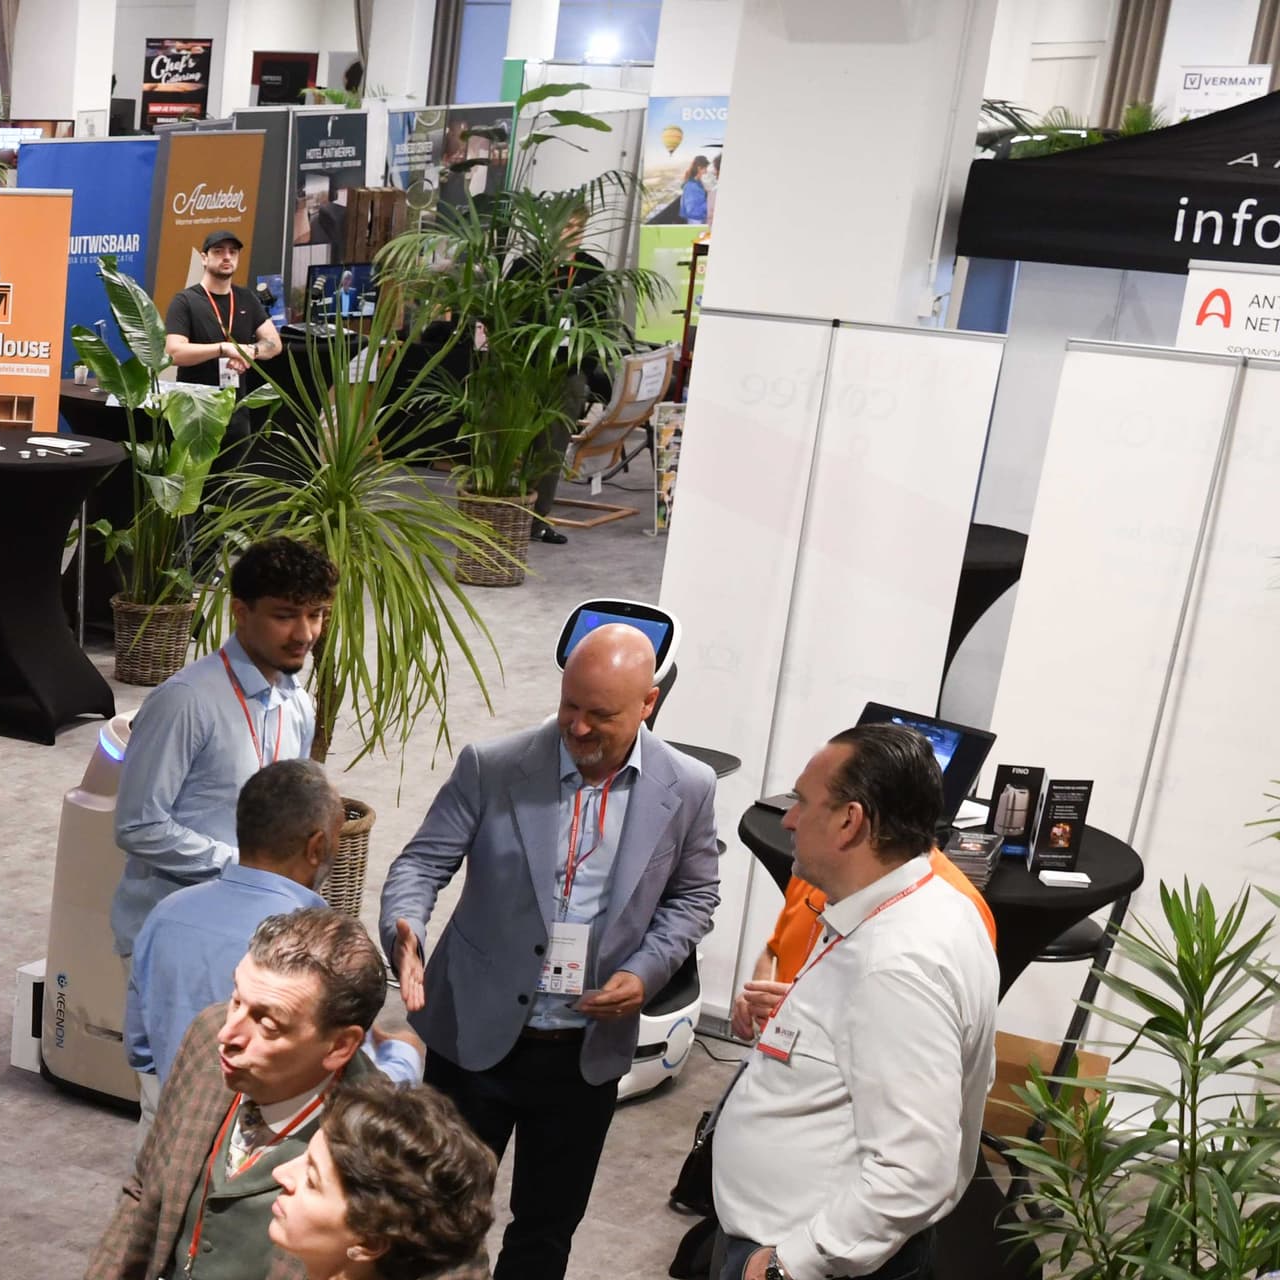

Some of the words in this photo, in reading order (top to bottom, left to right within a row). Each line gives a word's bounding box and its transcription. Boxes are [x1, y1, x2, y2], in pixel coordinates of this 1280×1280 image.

[1204, 76, 1264, 86] VERMANT
[1174, 196, 1280, 249] info
[69, 233, 140, 255] UITWISBAAR
[1011, 767, 1029, 776] FINO
[56, 991, 66, 1049] KEENON
